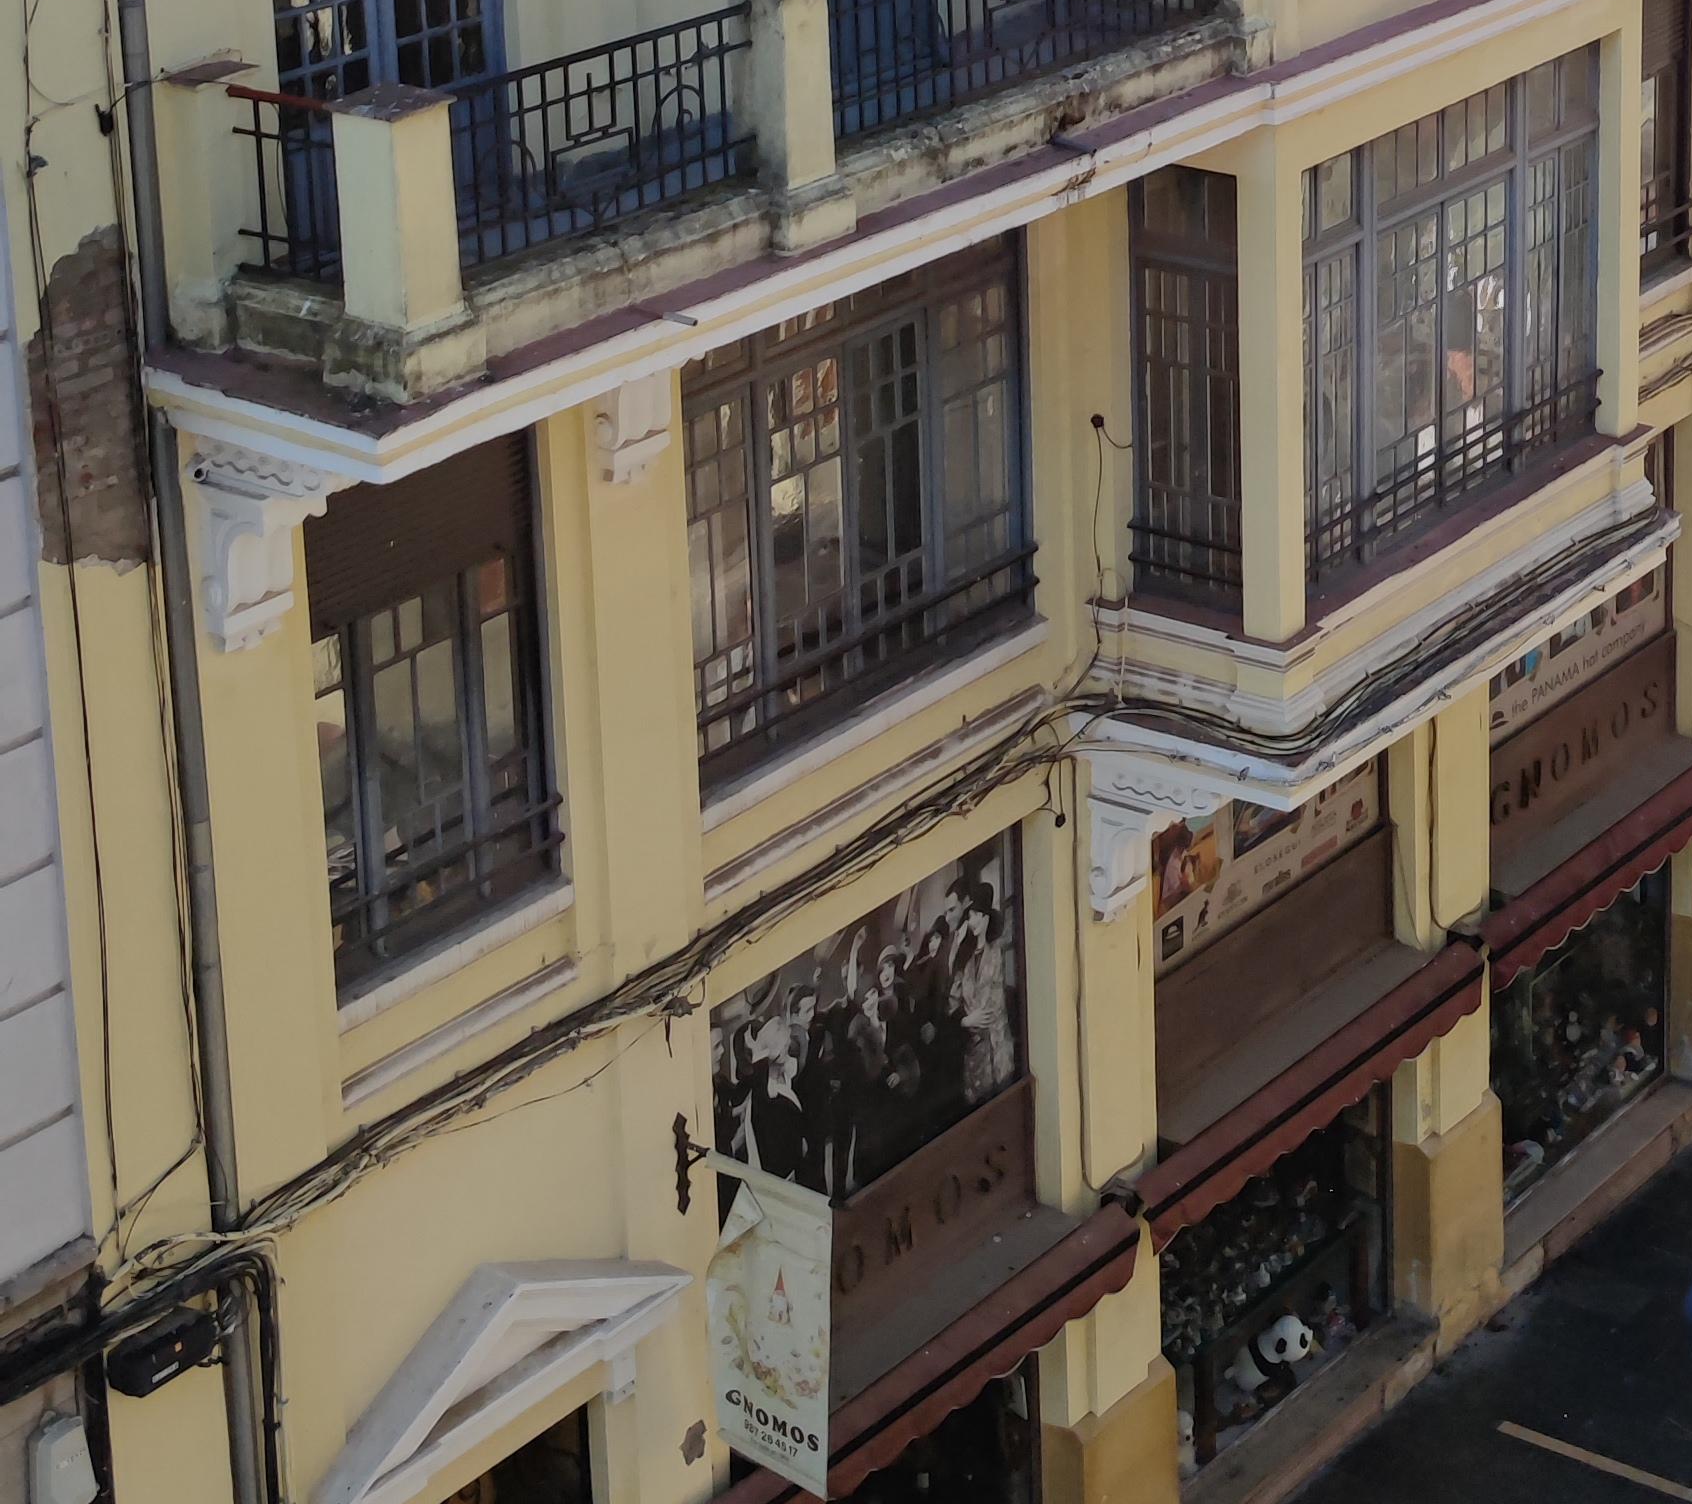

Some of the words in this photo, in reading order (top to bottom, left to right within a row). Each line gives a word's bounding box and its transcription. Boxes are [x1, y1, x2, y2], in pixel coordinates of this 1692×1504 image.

[1511, 698, 1529, 718] the
[1531, 662, 1580, 705] PANAMA
[1582, 647, 1599, 674] hat
[1601, 623, 1645, 660] company
[1491, 681, 1659, 826] GNOMOS
[725, 1389, 820, 1452] GNOMOS
